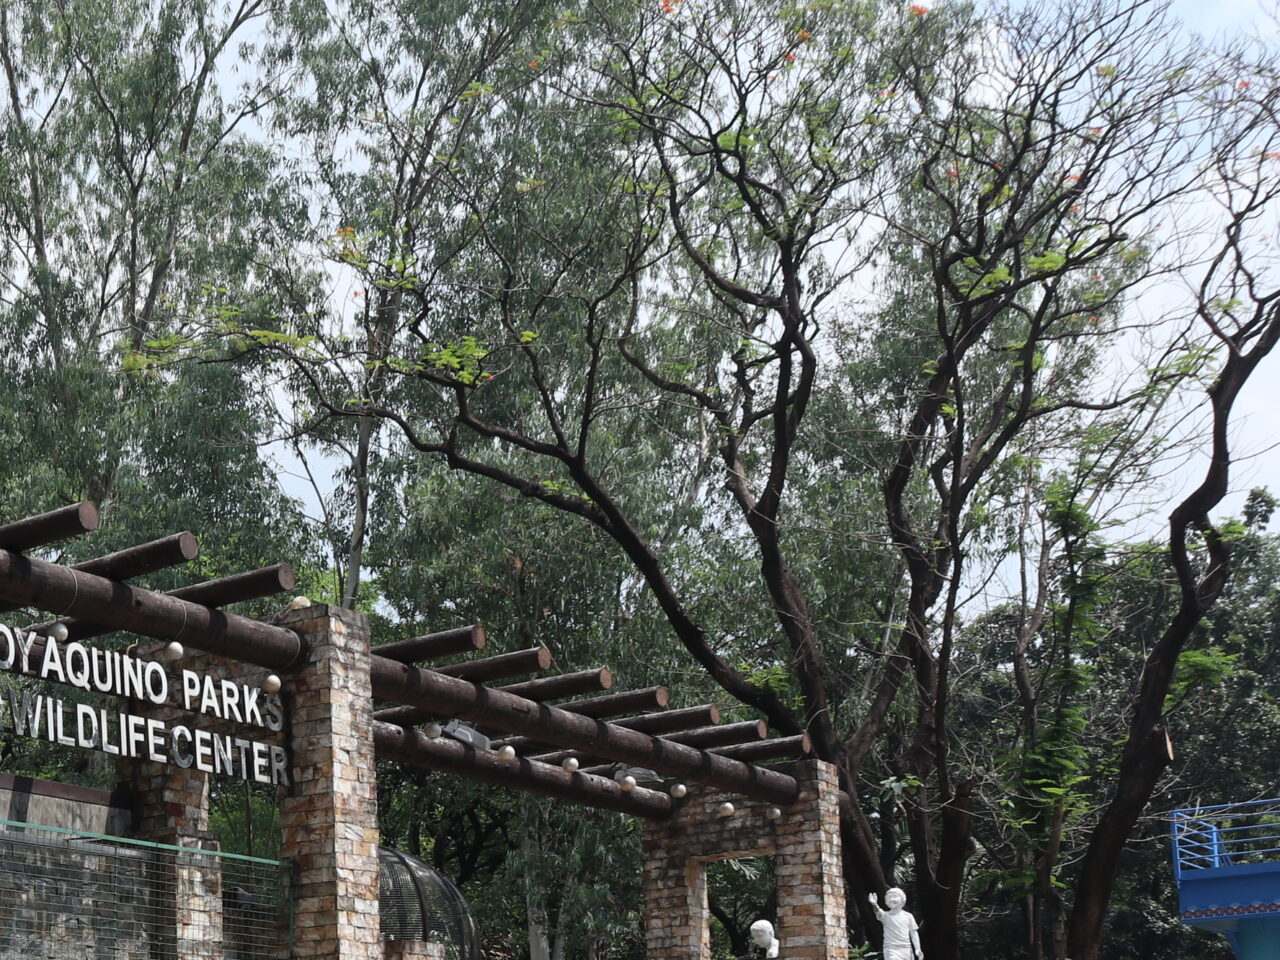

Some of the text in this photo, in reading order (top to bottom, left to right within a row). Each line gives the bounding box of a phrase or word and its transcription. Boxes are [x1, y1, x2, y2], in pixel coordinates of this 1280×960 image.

[41, 635, 168, 705] AQUINO
[183, 668, 283, 732] PARKS
[9, 687, 167, 764] WILDLIFE
[171, 725, 291, 787] CENTER
